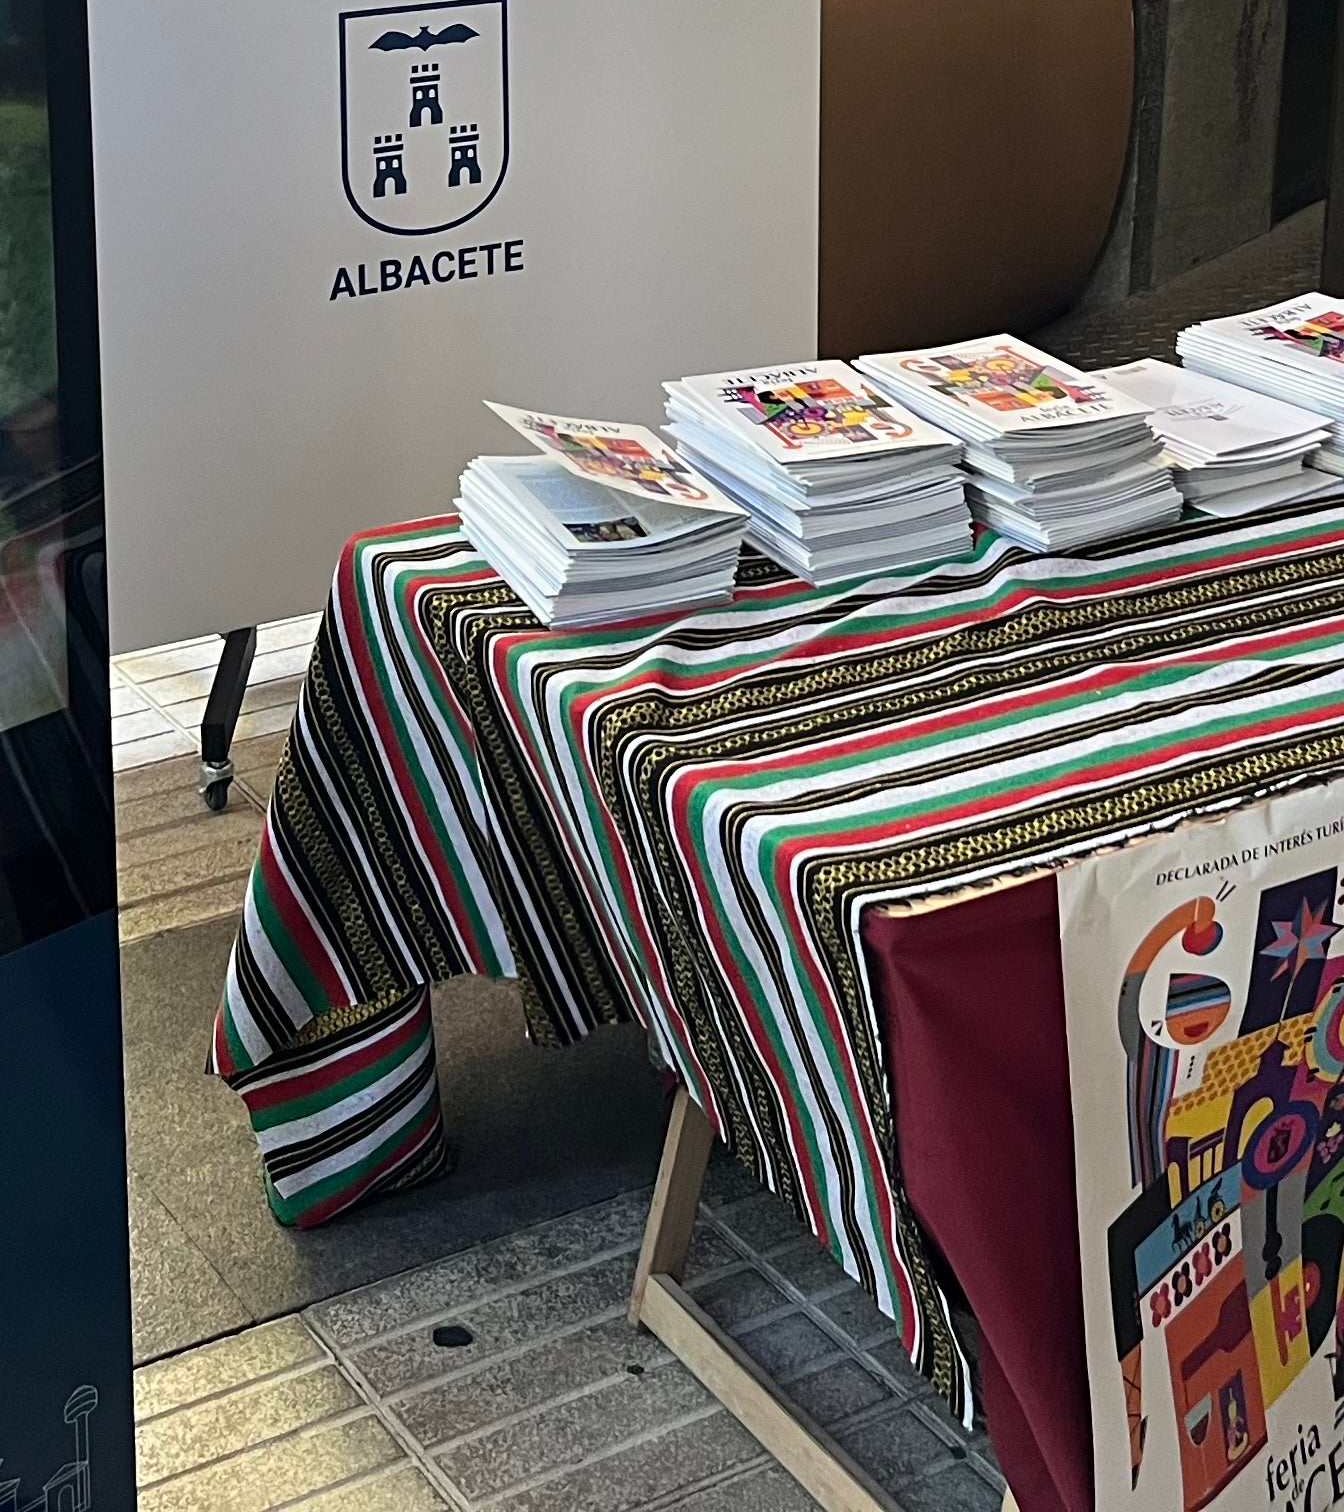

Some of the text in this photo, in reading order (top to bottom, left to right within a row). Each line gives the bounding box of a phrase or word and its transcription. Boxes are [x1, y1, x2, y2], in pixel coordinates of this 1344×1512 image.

[328, 239, 525, 302] ALBACETE
[1155, 853, 1239, 886] DECLARADA
[1241, 845, 1260, 862] DE
[1264, 831, 1313, 859] INTERÉS
[1265, 1423, 1321, 1502] feria
